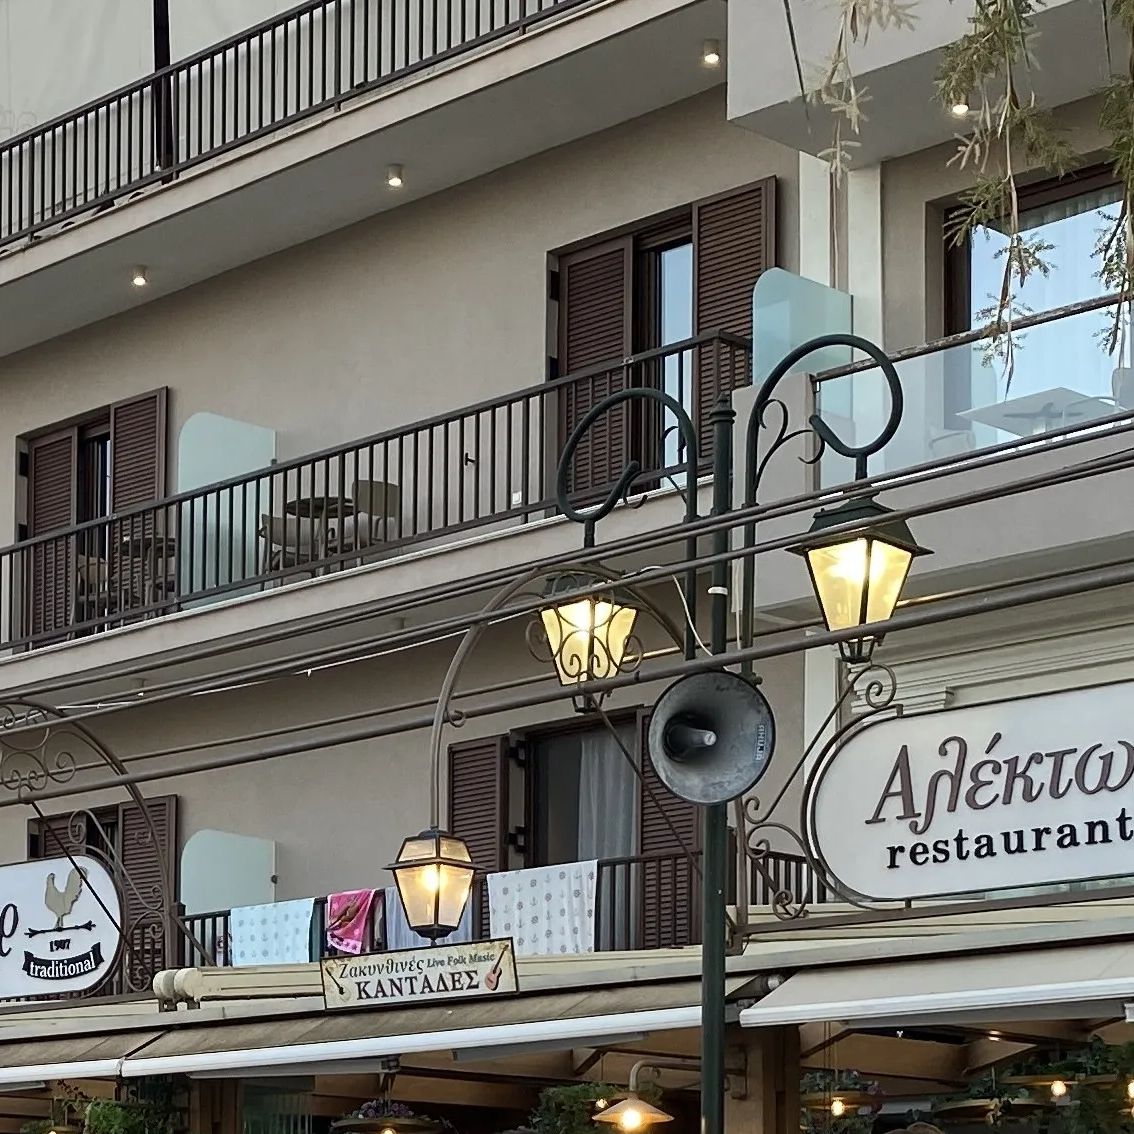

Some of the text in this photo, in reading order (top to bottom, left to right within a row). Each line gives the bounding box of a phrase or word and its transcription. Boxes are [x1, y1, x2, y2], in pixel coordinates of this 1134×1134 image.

[865, 732, 1134, 835] Αλέκτω
[886, 807, 1134, 869] restaurant
[29, 951, 96, 978] traditional
[339, 955, 424, 979] Ζακυνθινές
[426, 952, 496, 968] Live Folk Music
[355, 969, 480, 1001] ΚΑΝΤΑΔΕΣ
